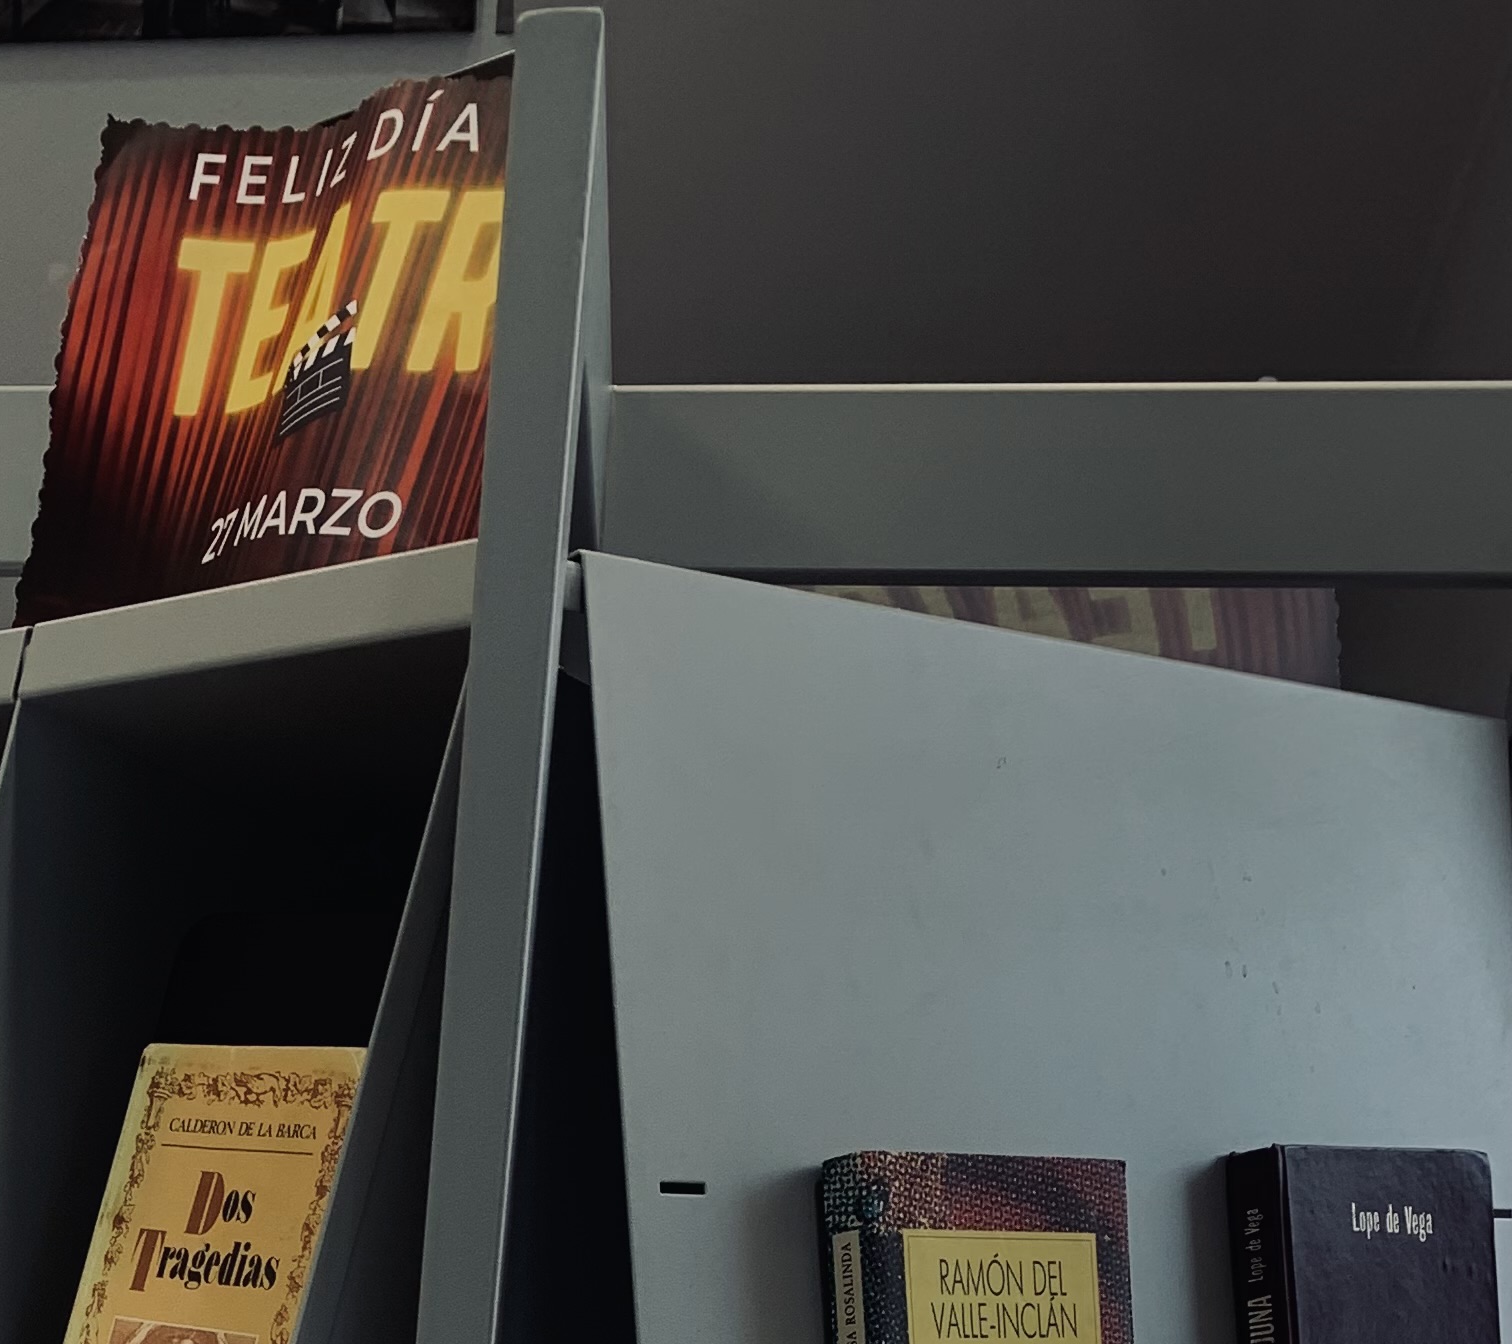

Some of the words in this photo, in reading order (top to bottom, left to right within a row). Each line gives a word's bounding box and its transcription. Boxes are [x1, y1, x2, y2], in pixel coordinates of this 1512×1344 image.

[188, 132, 356, 205] FELIZ
[367, 91, 480, 162] DÍA
[201, 509, 239, 565] 27
[235, 487, 403, 547] MARZO
[238, 1121, 256, 1137] DE
[257, 1123, 273, 1138] LA
[275, 1123, 318, 1141] BARCA
[184, 1170, 257, 1236] Dos
[1244, 1208, 1264, 1236] Vega
[1351, 1202, 1380, 1239] Lope
[1386, 1204, 1400, 1234] de
[1404, 1206, 1433, 1242] Vega
[129, 1228, 282, 1292] Tragedias
[938, 1252, 1025, 1297] RAMÓN
[1032, 1260, 1068, 1297] DEL
[1248, 1255, 1268, 1283] Lope
[841, 1241, 857, 1328] ROSALINDA
[930, 1296, 1079, 1340] VALLE-INCLÁN
